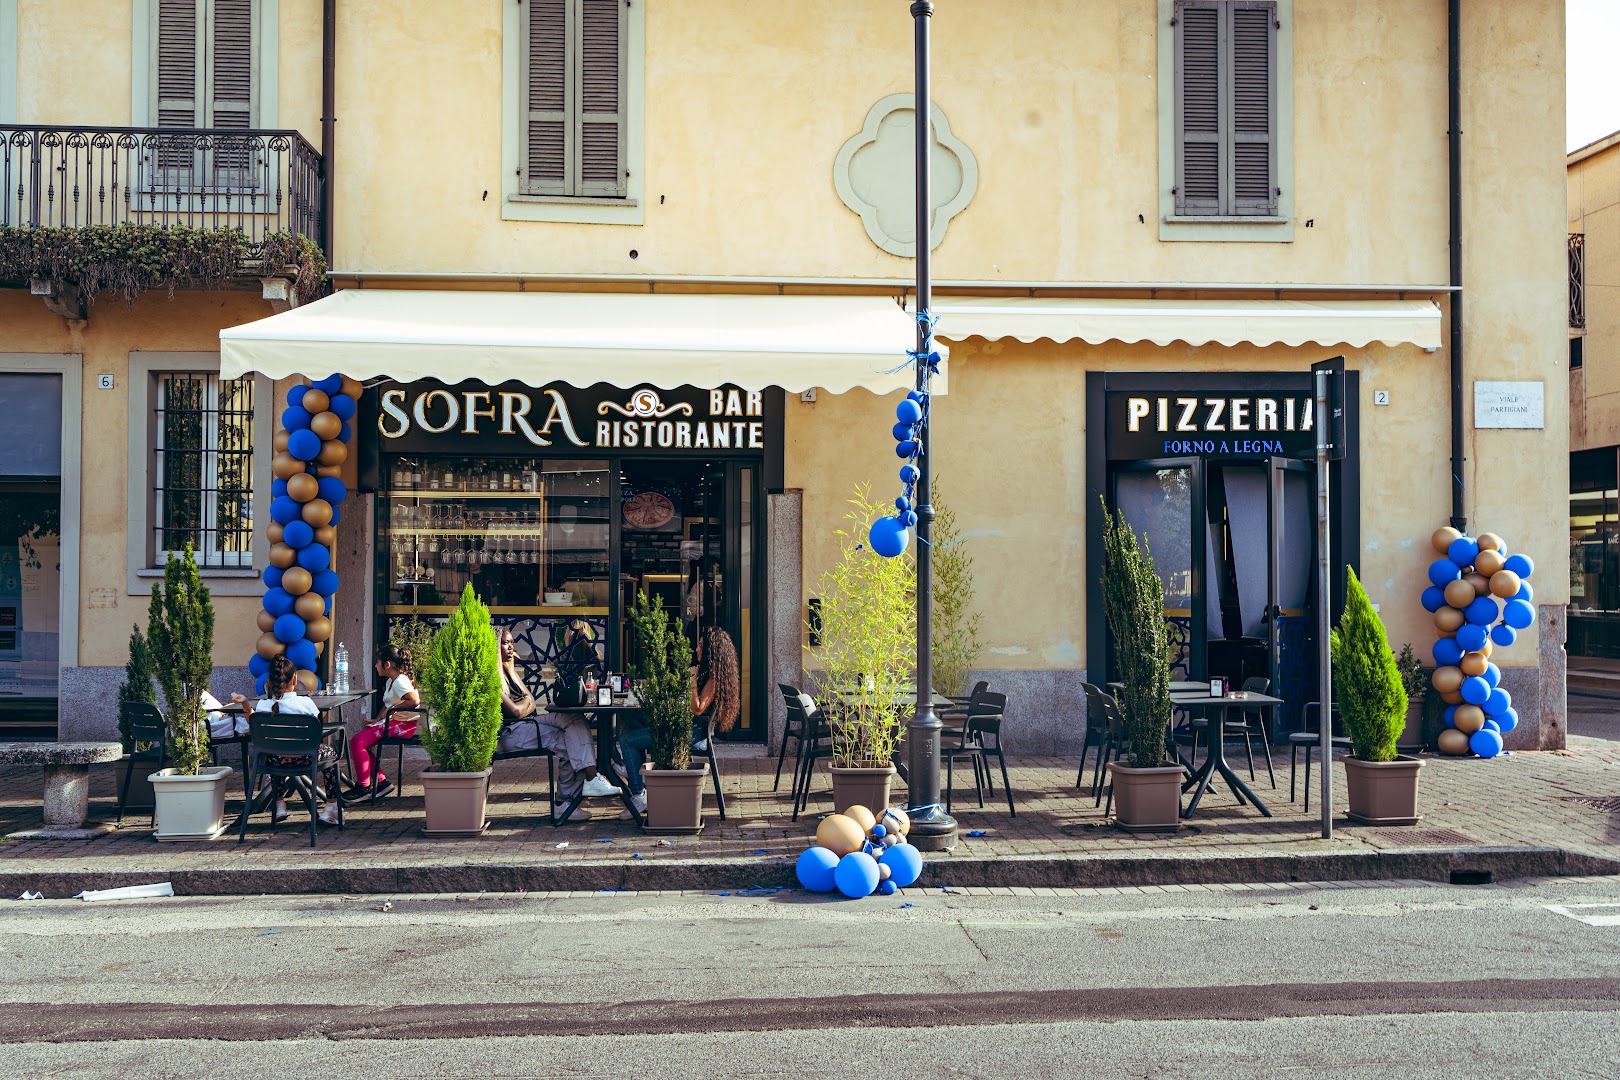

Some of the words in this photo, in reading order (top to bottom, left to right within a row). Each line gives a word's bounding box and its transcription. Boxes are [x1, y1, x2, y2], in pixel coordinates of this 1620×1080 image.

[102, 376, 110, 387] 6
[709, 388, 763, 416] BAR
[805, 389, 812, 400] 4
[1378, 392, 1386, 403] 2
[639, 394, 652, 411] S
[378, 389, 590, 447] SOFRA
[596, 419, 763, 449] RISTORANTE
[1163, 440, 1215, 453] FORNO
[1219, 440, 1230, 453] A
[1234, 440, 1284, 453] LEGNA
